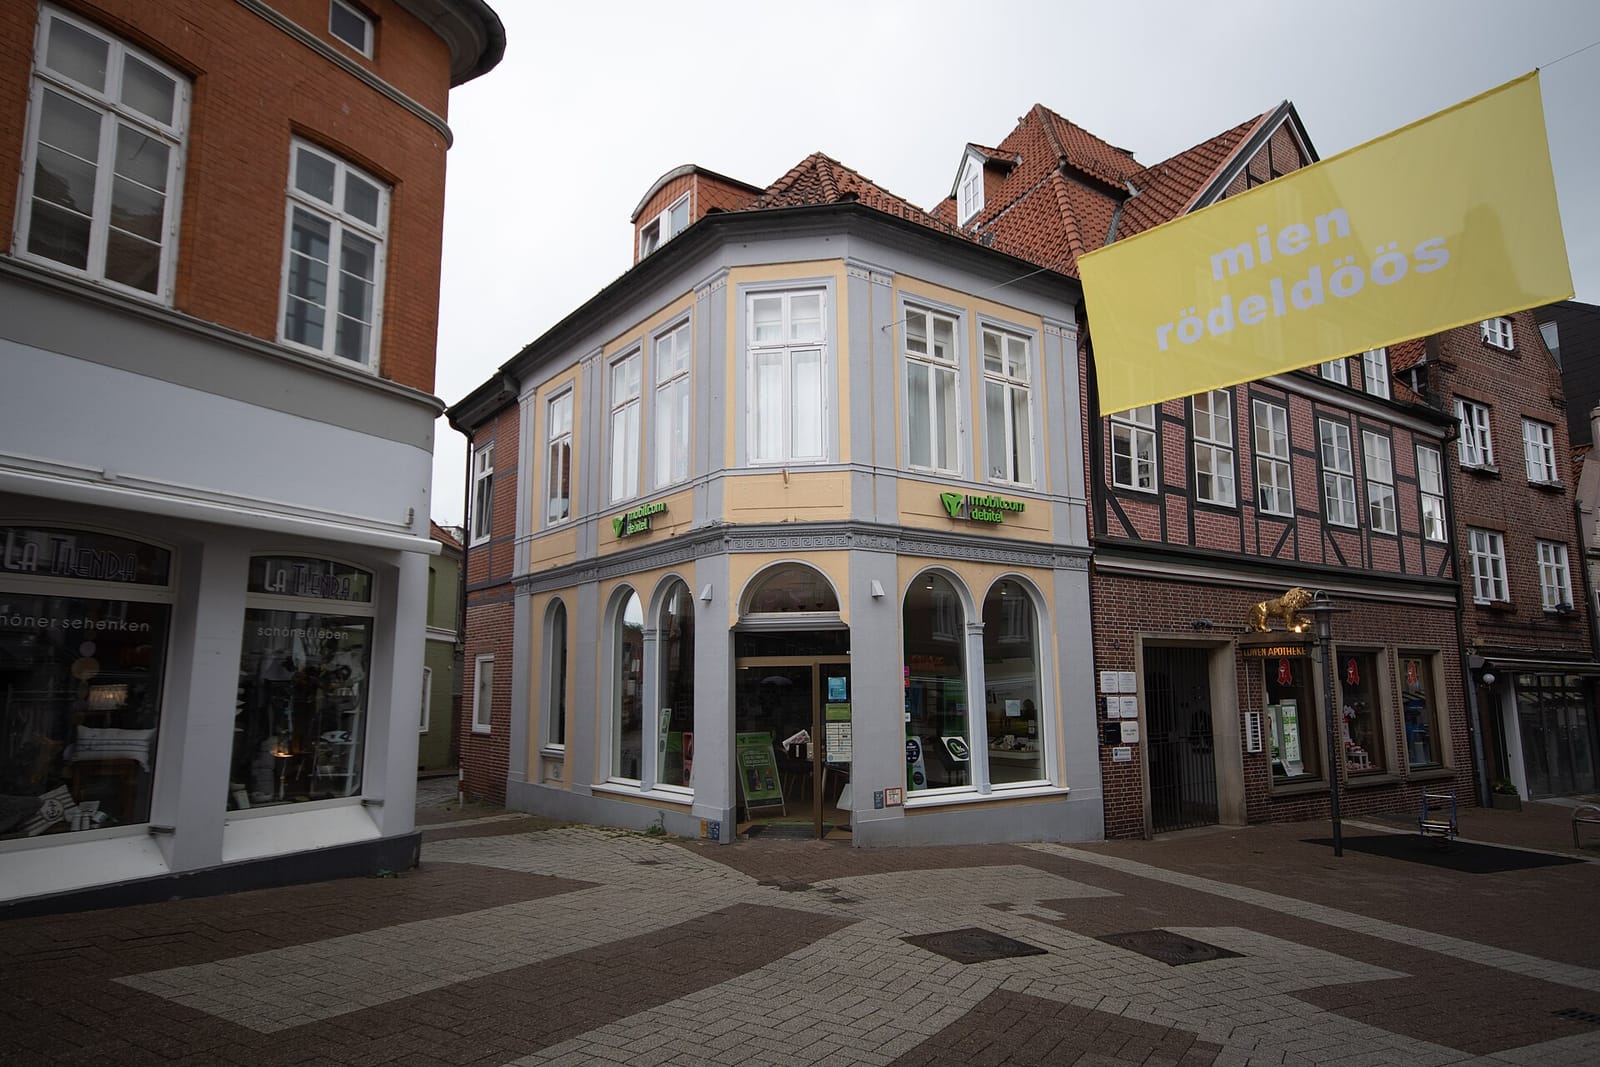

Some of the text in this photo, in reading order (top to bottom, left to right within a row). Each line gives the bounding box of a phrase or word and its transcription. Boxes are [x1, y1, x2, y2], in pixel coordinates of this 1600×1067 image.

[1210, 207, 1350, 281] mien
[1156, 237, 1451, 351] rödeldöös
[970, 495, 1025, 512] mobilcom
[971, 508, 1004, 524] debitel
[1268, 646, 1307, 657] APOTHEKE
